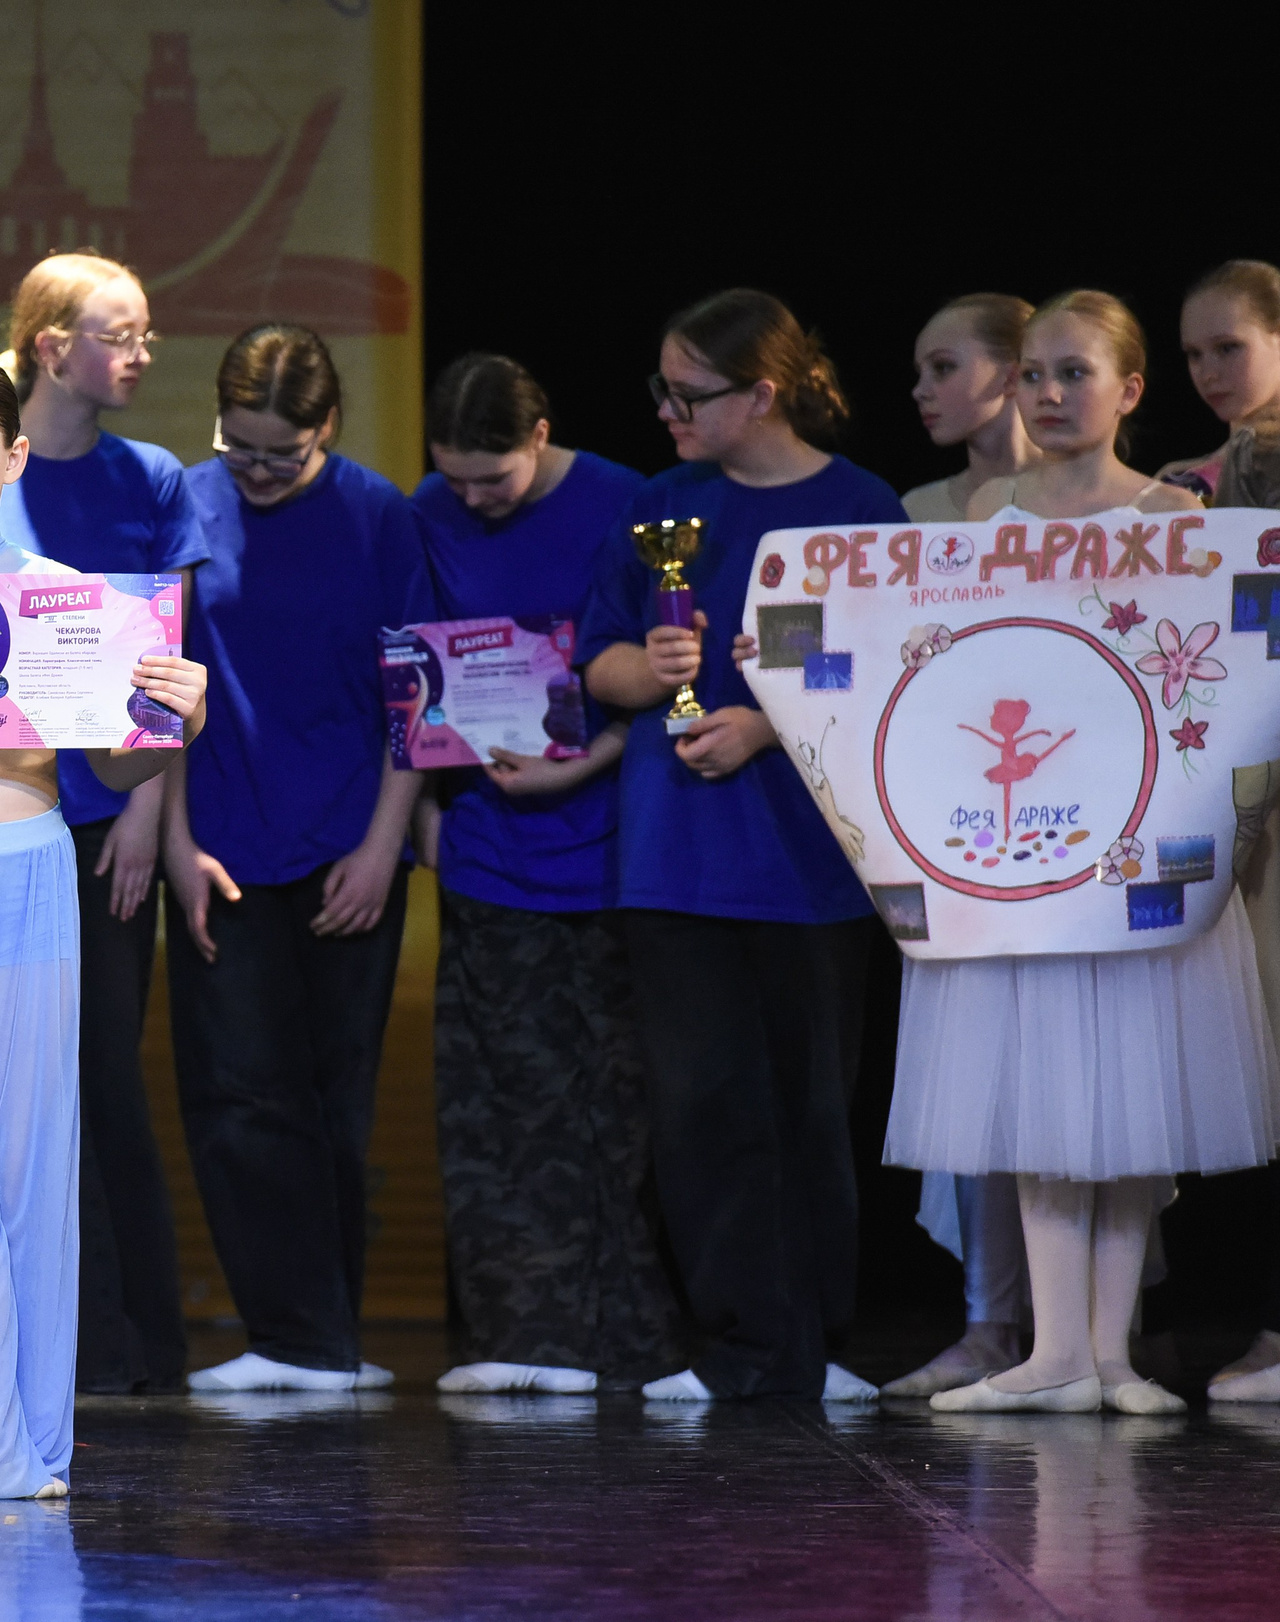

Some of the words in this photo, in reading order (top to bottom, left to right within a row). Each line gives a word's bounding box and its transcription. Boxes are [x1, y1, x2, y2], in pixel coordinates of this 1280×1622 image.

[803, 529, 922, 587] ФЕЯ
[978, 515, 1206, 582] ДРАЖЕ
[28, 591, 92, 610] ЛАУРЕАТ
[909, 585, 1005, 606] ЯРОСЛАВЛЬ
[55, 627, 102, 635] ЧЕКАУРОВА
[57, 637, 100, 645] ВИКТОРИЯ
